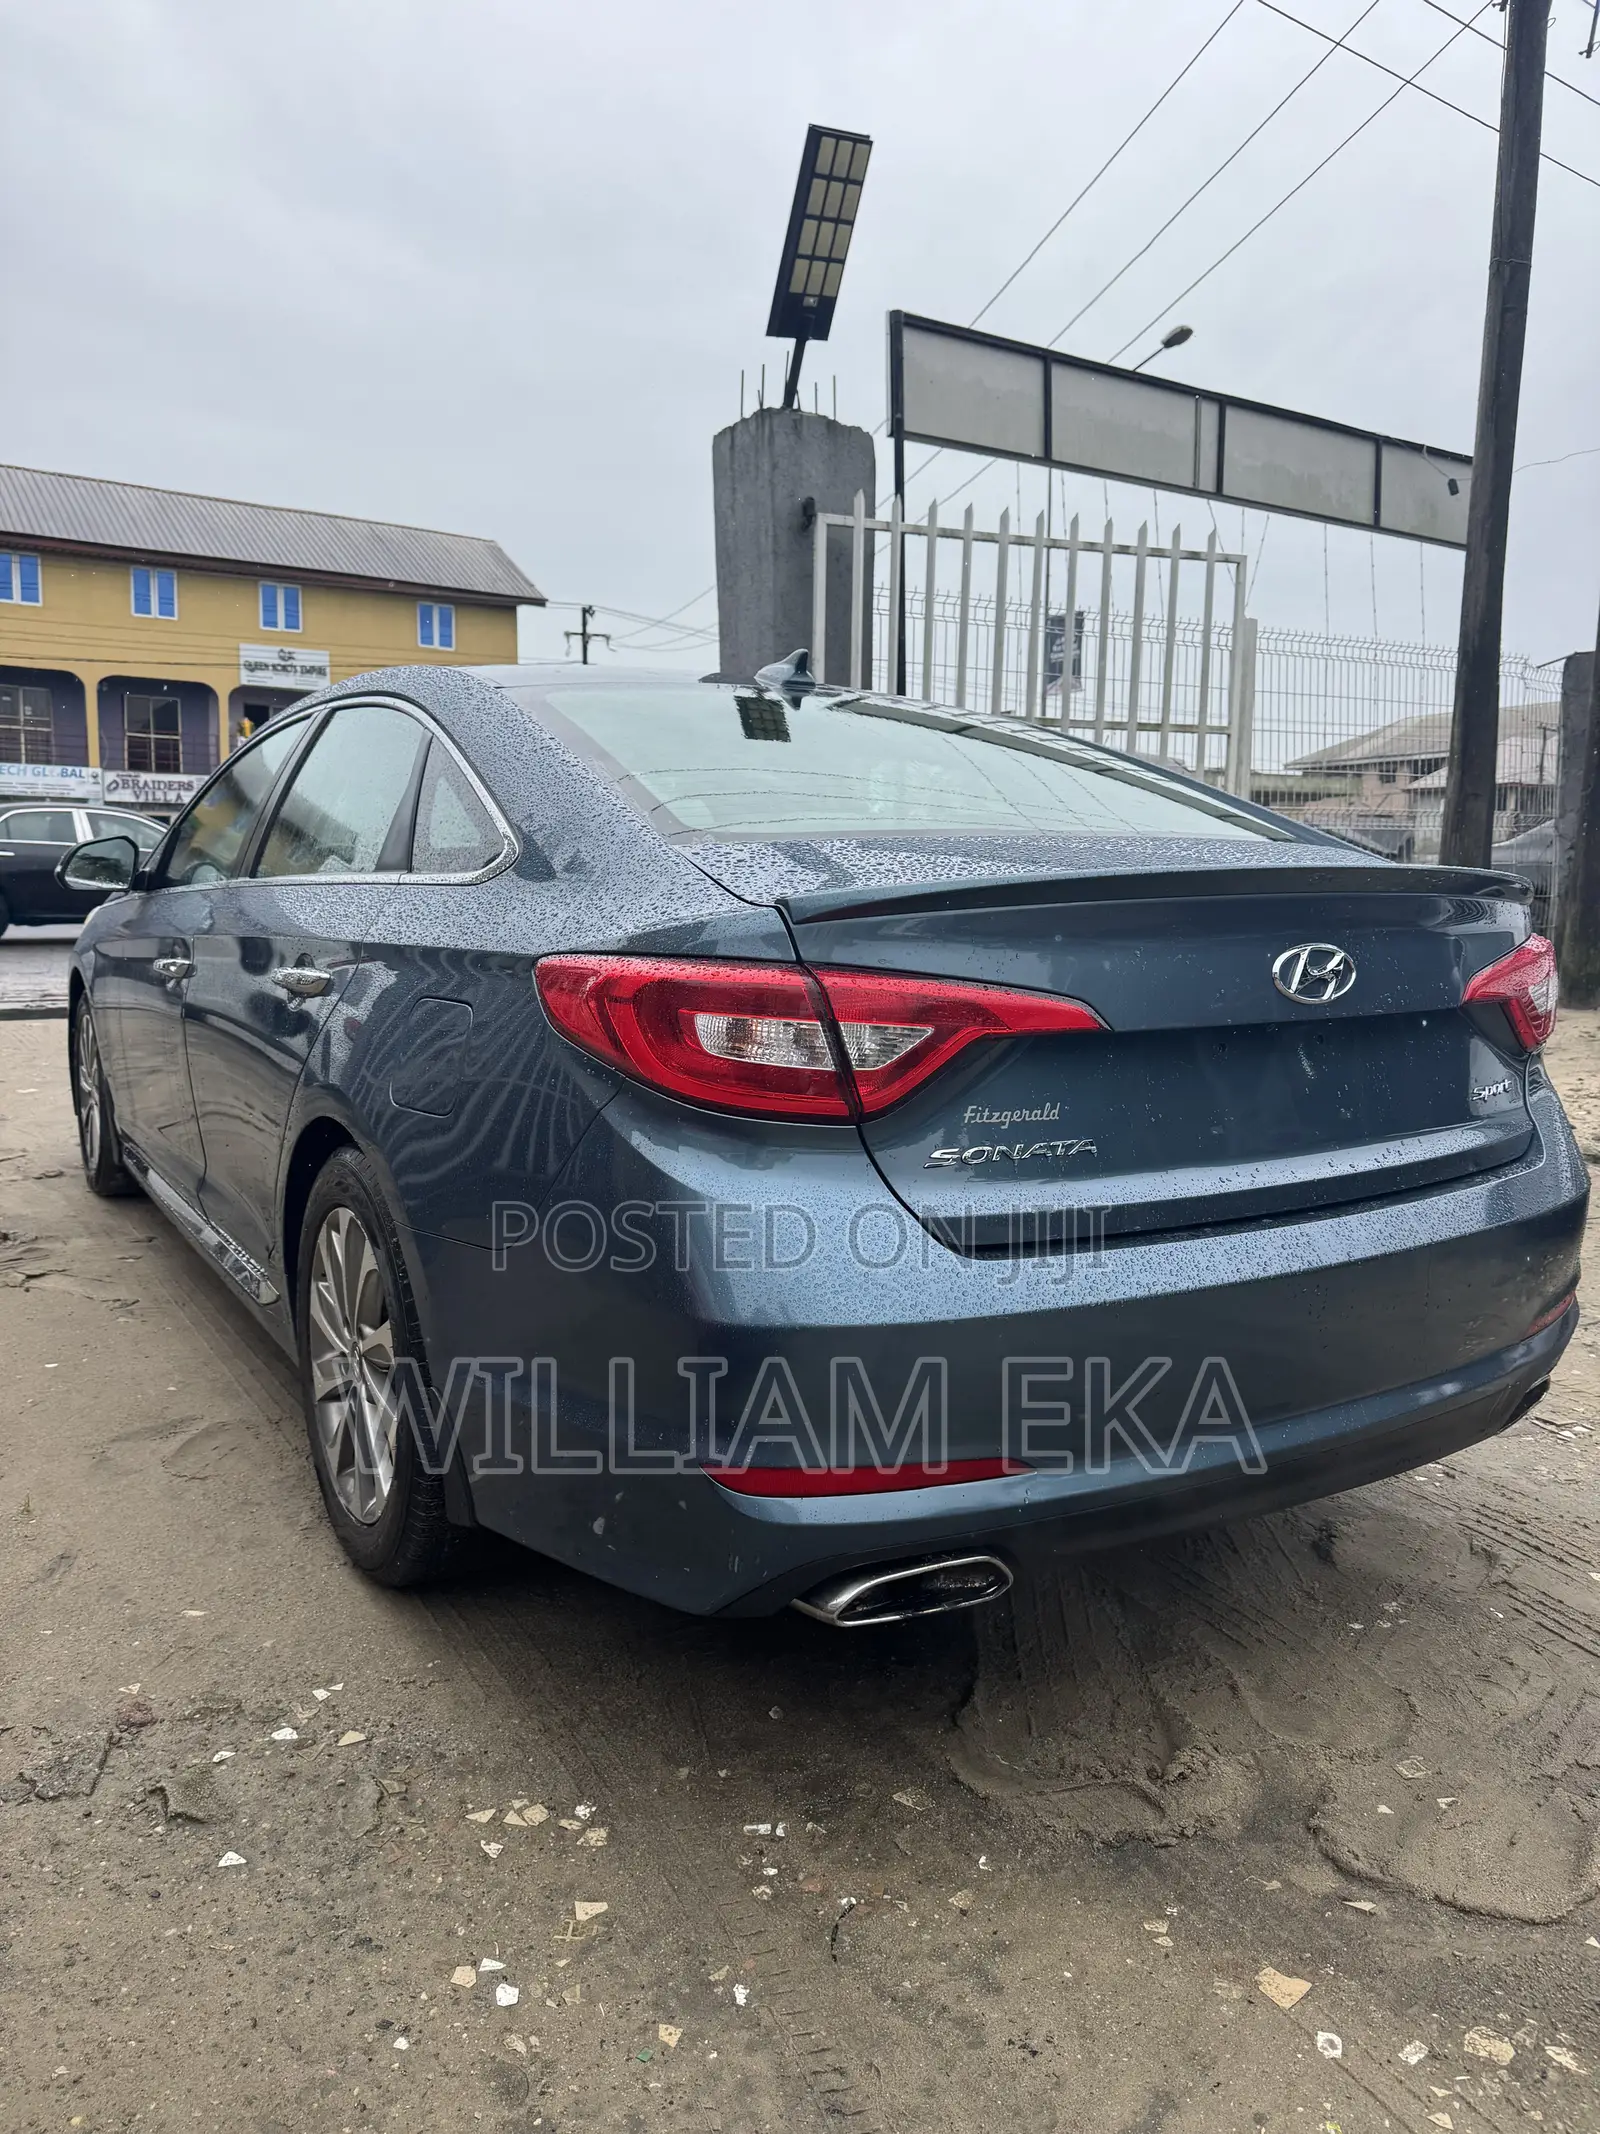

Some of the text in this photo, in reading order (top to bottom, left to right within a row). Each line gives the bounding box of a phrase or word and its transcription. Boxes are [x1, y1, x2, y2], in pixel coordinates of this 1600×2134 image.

[120, 778, 194, 791] BRAIDERS
[132, 790, 185, 802] VILLA
[1472, 1079, 1512, 1101] Sport
[963, 1102, 1061, 1129] Fitzgerald
[923, 1138, 1098, 1168] SONATA
